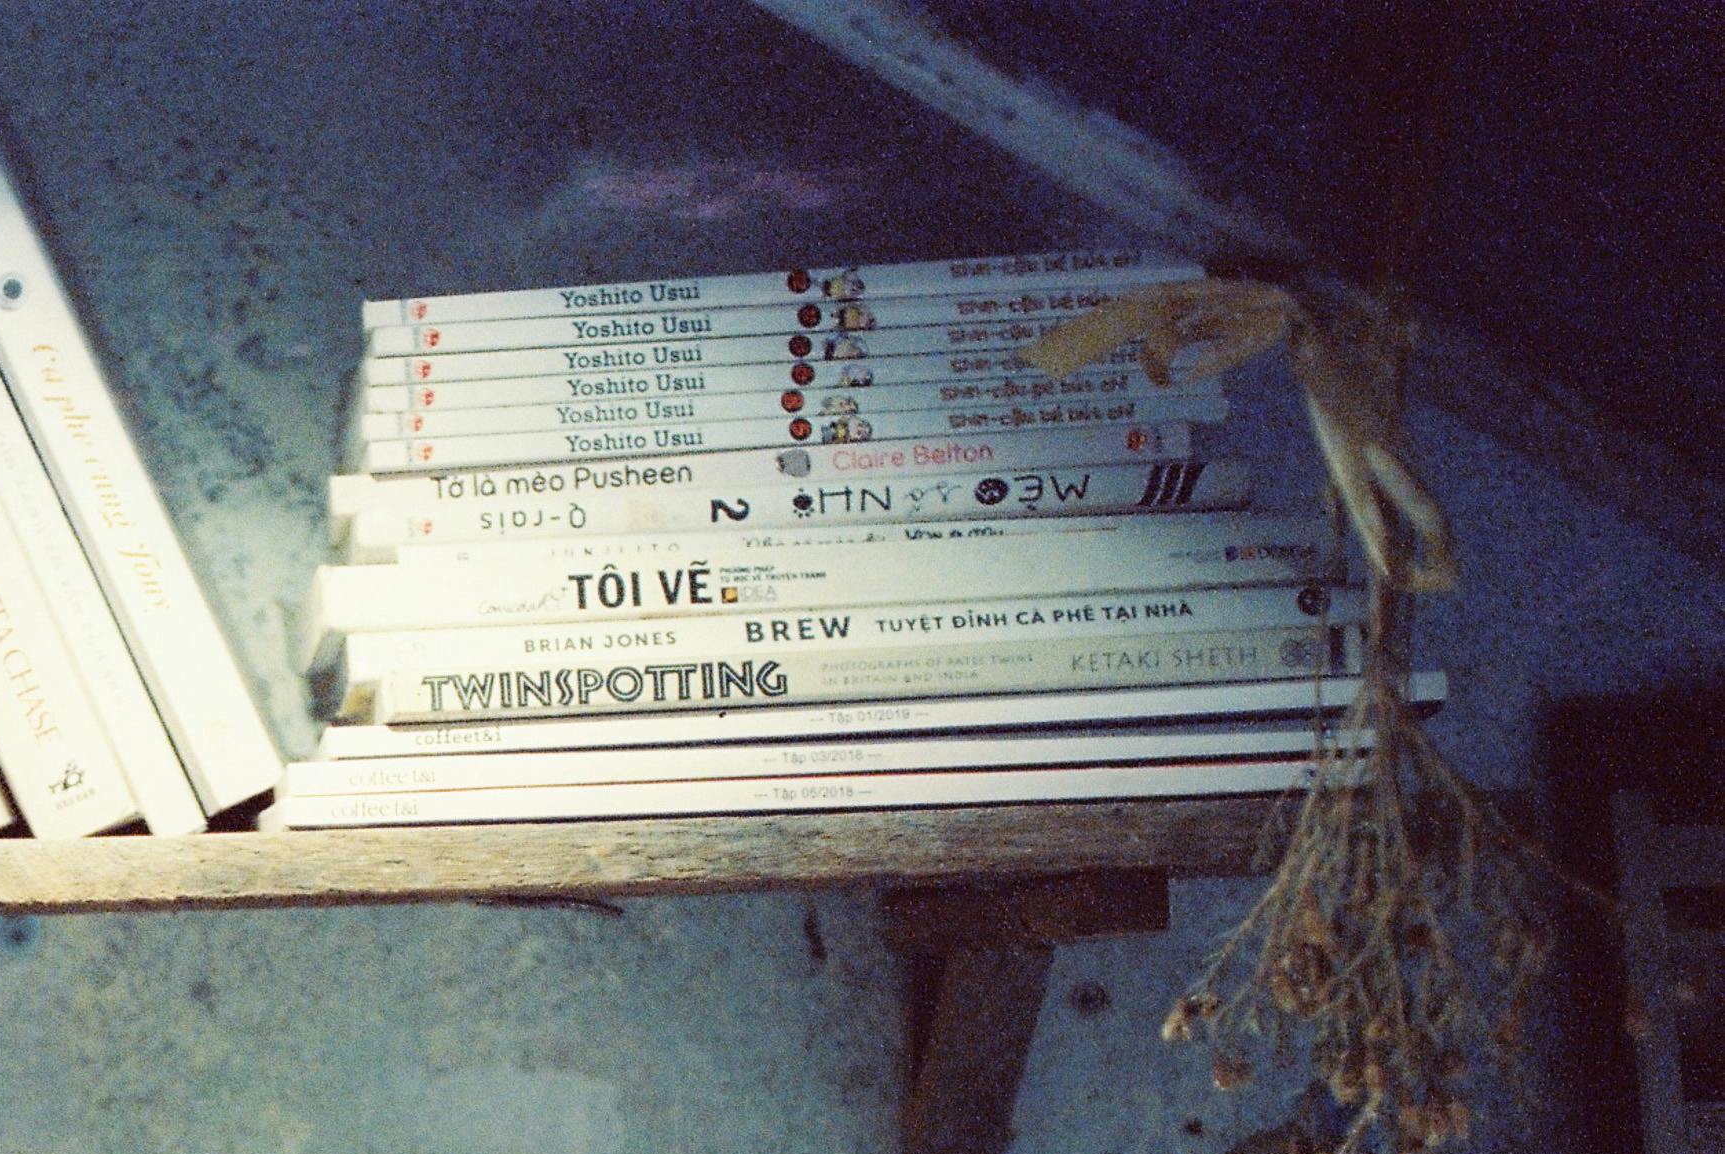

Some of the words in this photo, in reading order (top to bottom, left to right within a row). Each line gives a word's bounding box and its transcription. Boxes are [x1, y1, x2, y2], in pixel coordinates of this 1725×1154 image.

[560, 286, 643, 310] Yoshito
[651, 283, 701, 302] Usui
[573, 318, 655, 341] Yoshito
[665, 314, 712, 336] Usui
[563, 349, 646, 372] Yoshito
[656, 344, 703, 366] Usui
[566, 376, 649, 398] Yoshito
[659, 372, 706, 394] Usui
[556, 403, 638, 425] Yoshito
[648, 399, 695, 420] Usui
[565, 432, 648, 455] Yoshito
[657, 427, 704, 449] Usui
[831, 446, 907, 472] Claire
[913, 441, 994, 467] Belton
[475, 473, 497, 497] là
[507, 469, 566, 496] mèo
[575, 465, 694, 490] Pusheen
[480, 506, 588, 531] Q-rais
[117, 537, 180, 618] Tony
[569, 563, 642, 611] TÔI
[658, 558, 715, 606] VẼ
[876, 614, 944, 635] TUYỆT
[952, 606, 1008, 632] ĐỈNH
[1016, 604, 1045, 626] CÀ
[1052, 602, 1096, 624] PHÊ
[1104, 602, 1139, 624] TẠI
[1146, 597, 1194, 620] NHÀ
[524, 634, 599, 654] BRIAN
[602, 630, 677, 650] JONES
[744, 615, 852, 643] BREW
[821, 659, 921, 673] PHOTOGRAPHS
[924, 659, 943, 669] OF
[989, 653, 1034, 665] TWINS
[1070, 650, 1161, 673] KETAKI
[1173, 646, 1258, 668] SHETH
[421, 659, 790, 712] TWINSPOTTING
[822, 676, 835, 686] IN
[842, 673, 898, 686] BRITAIN
[904, 671, 932, 683] AND
[939, 669, 979, 682] INDIA
[828, 706, 855, 726] Tập
[858, 705, 911, 724] 01/2019
[782, 748, 809, 767] Tập
[812, 747, 863, 765] 03/2018
[773, 786, 797, 804] Tập
[801, 784, 855, 802] 05/2018
